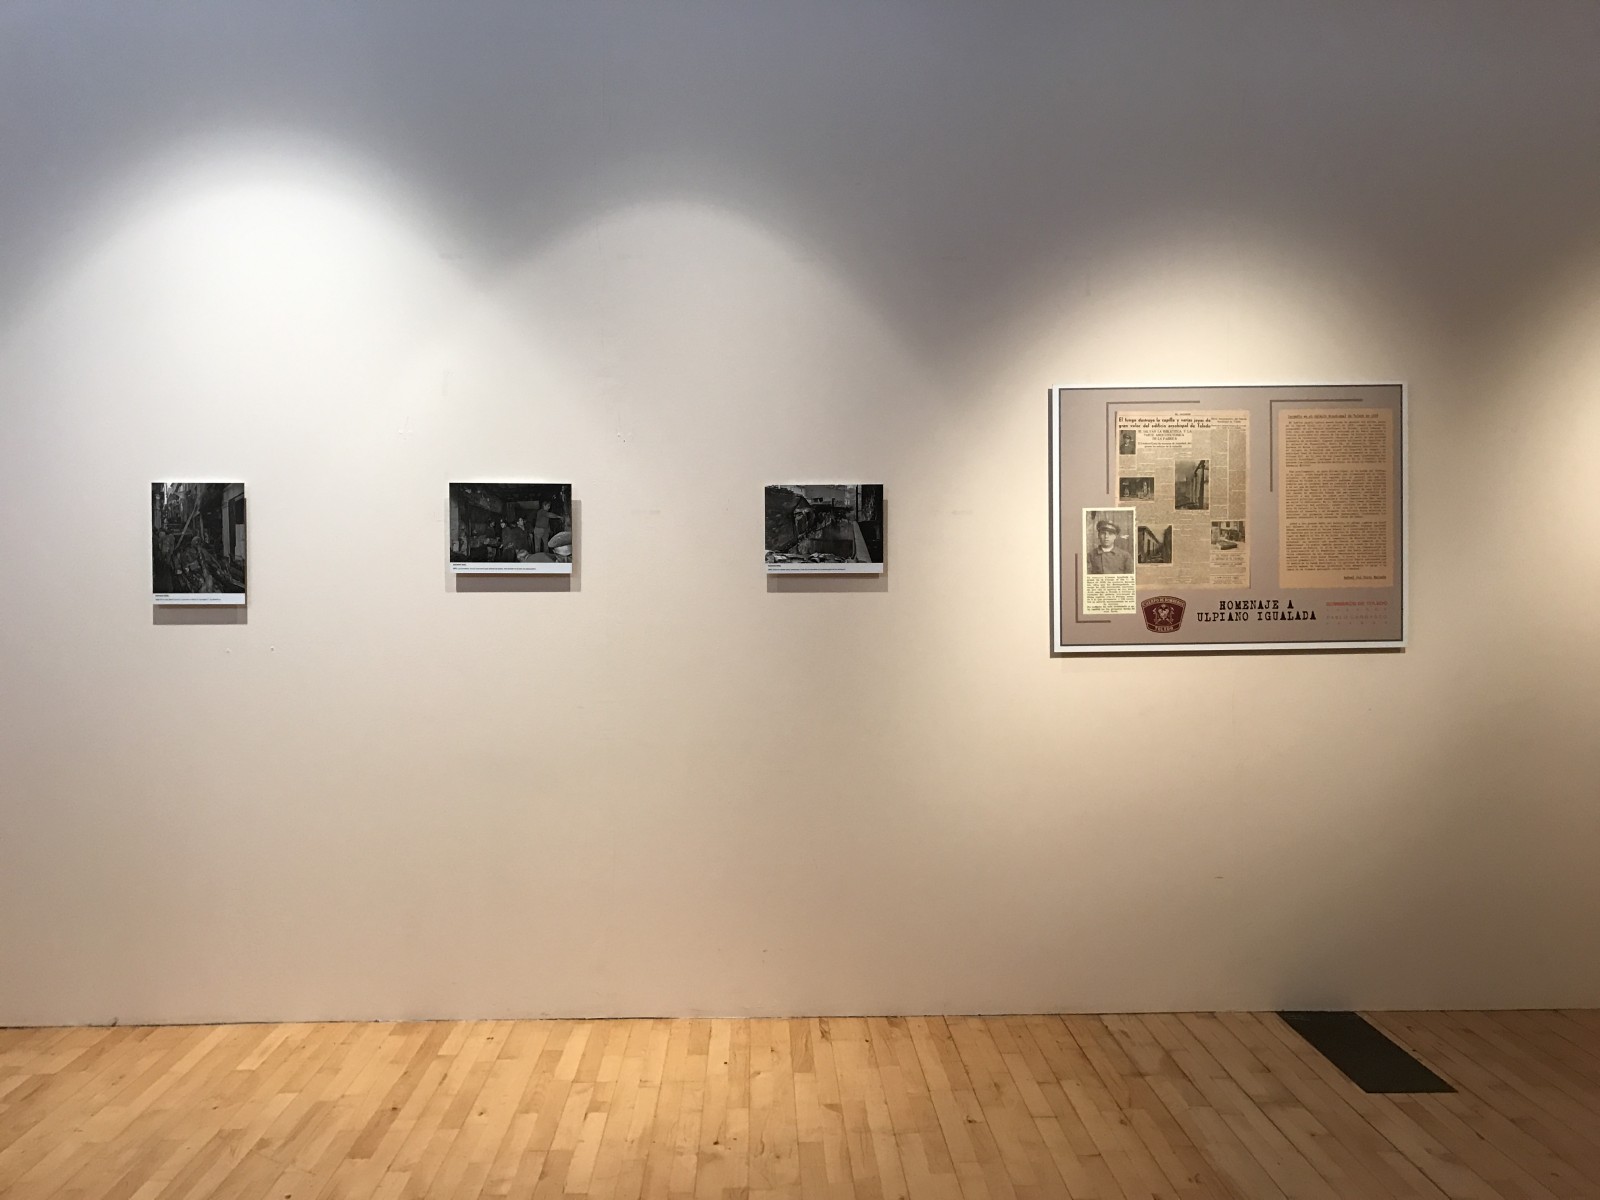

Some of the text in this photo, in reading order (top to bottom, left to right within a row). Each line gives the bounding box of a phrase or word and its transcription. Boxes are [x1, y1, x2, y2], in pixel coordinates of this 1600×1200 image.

[1219, 600, 1294, 611] HOMENAJE A
[1197, 611, 1317, 622] ULPIANO IGUALADA
